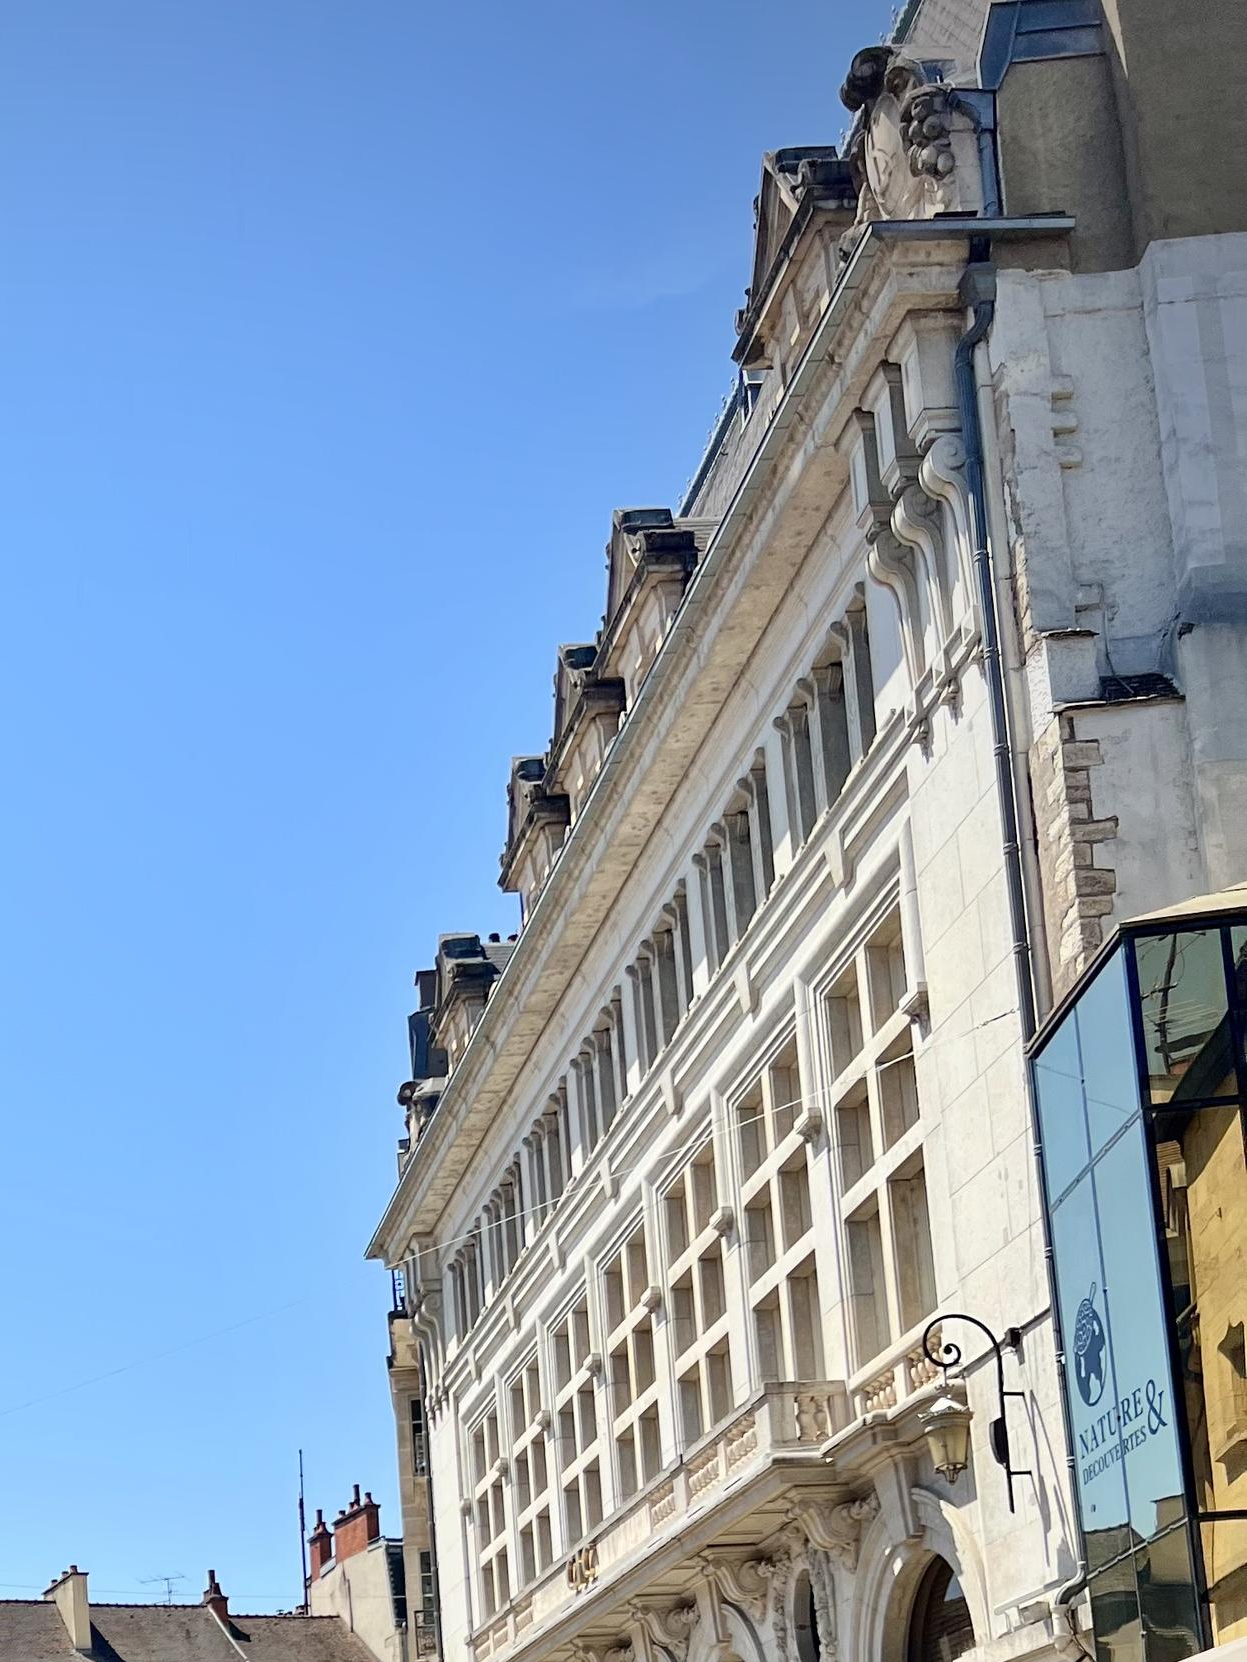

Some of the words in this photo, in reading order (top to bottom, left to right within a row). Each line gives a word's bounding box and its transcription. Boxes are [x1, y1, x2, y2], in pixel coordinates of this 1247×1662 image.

[1079, 1387, 1144, 1460] NATURE
[1146, 1379, 1168, 1435] &
[1082, 1425, 1147, 1486] DECOUVERTES
